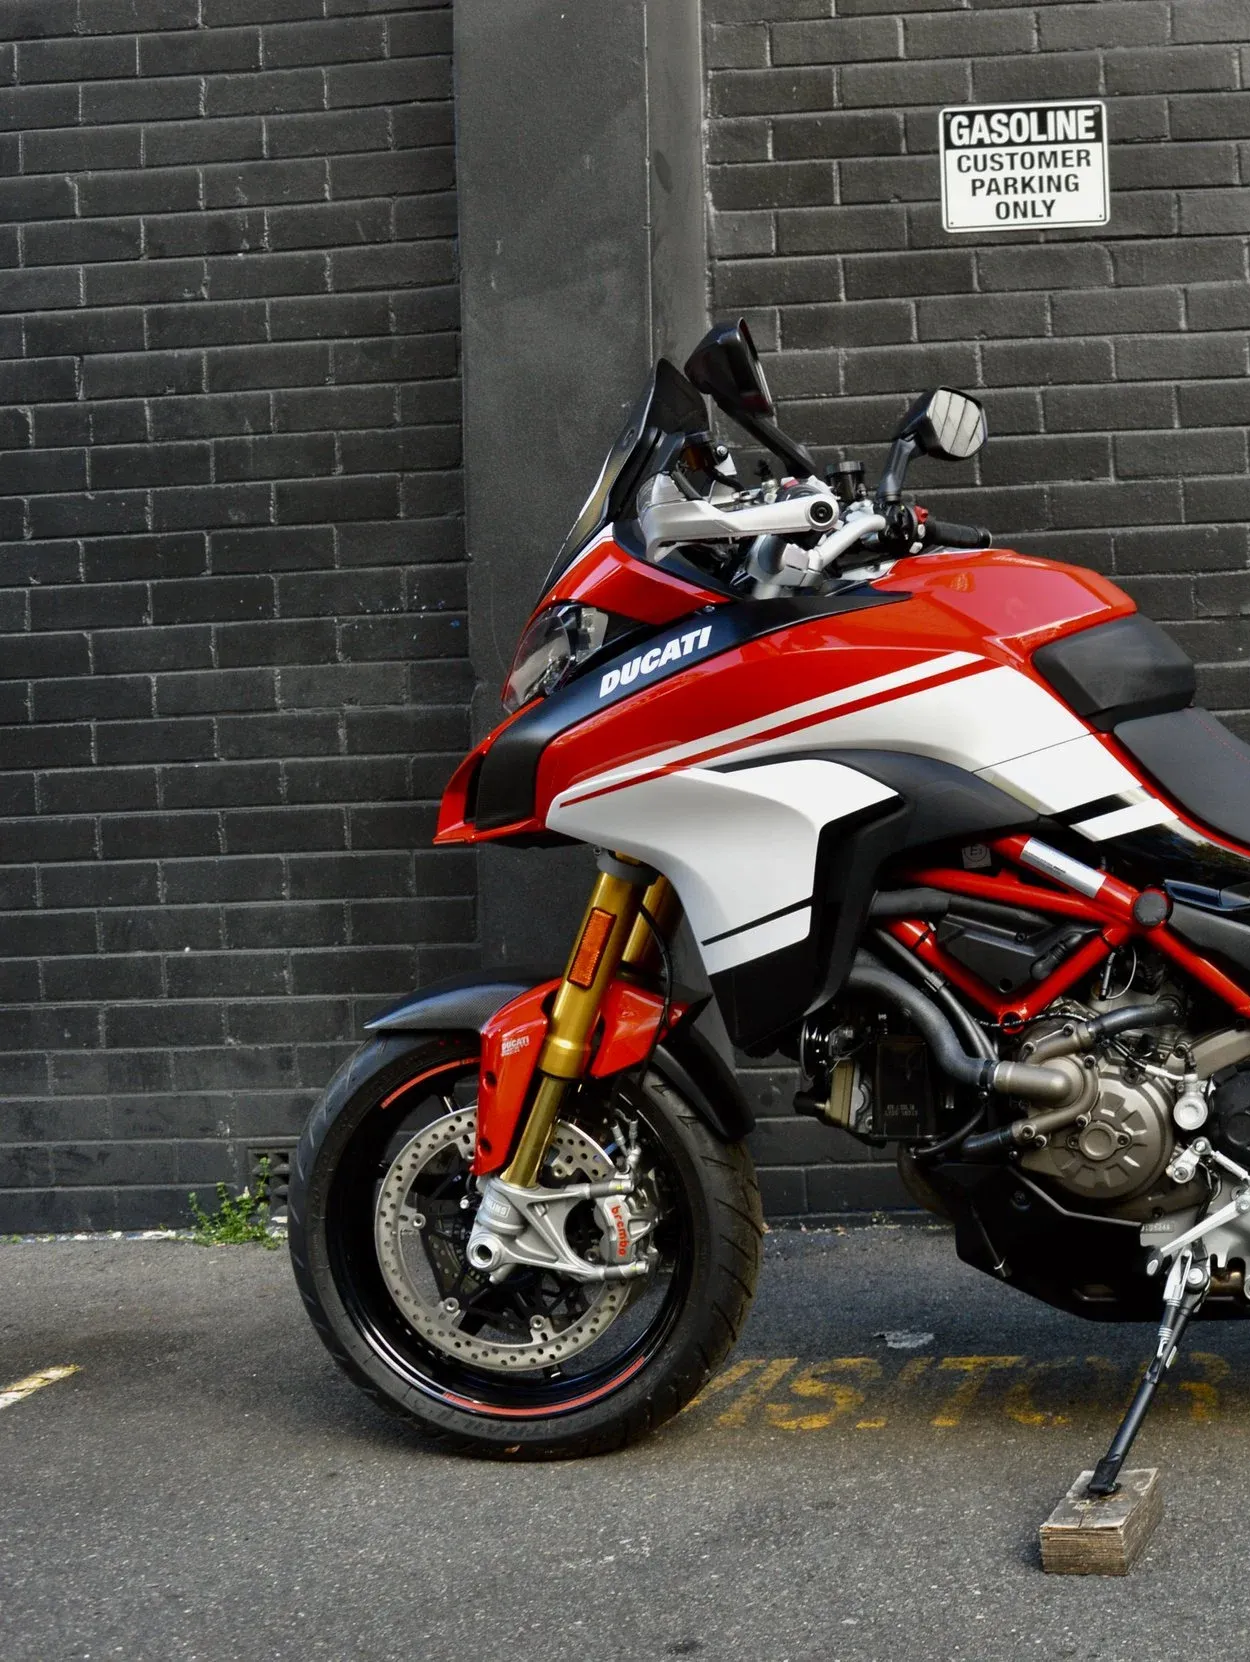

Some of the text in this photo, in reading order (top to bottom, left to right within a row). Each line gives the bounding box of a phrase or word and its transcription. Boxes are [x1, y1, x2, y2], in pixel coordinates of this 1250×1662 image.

[950, 109, 1096, 146] GASOLINE
[957, 149, 1091, 173] CUSTOMER
[971, 174, 1080, 197] PARKING
[995, 200, 1056, 220] ONLY
[599, 625, 712, 698] DUCATI
[502, 1035, 530, 1051] DUCATI
[611, 1205, 629, 1257] brembo
